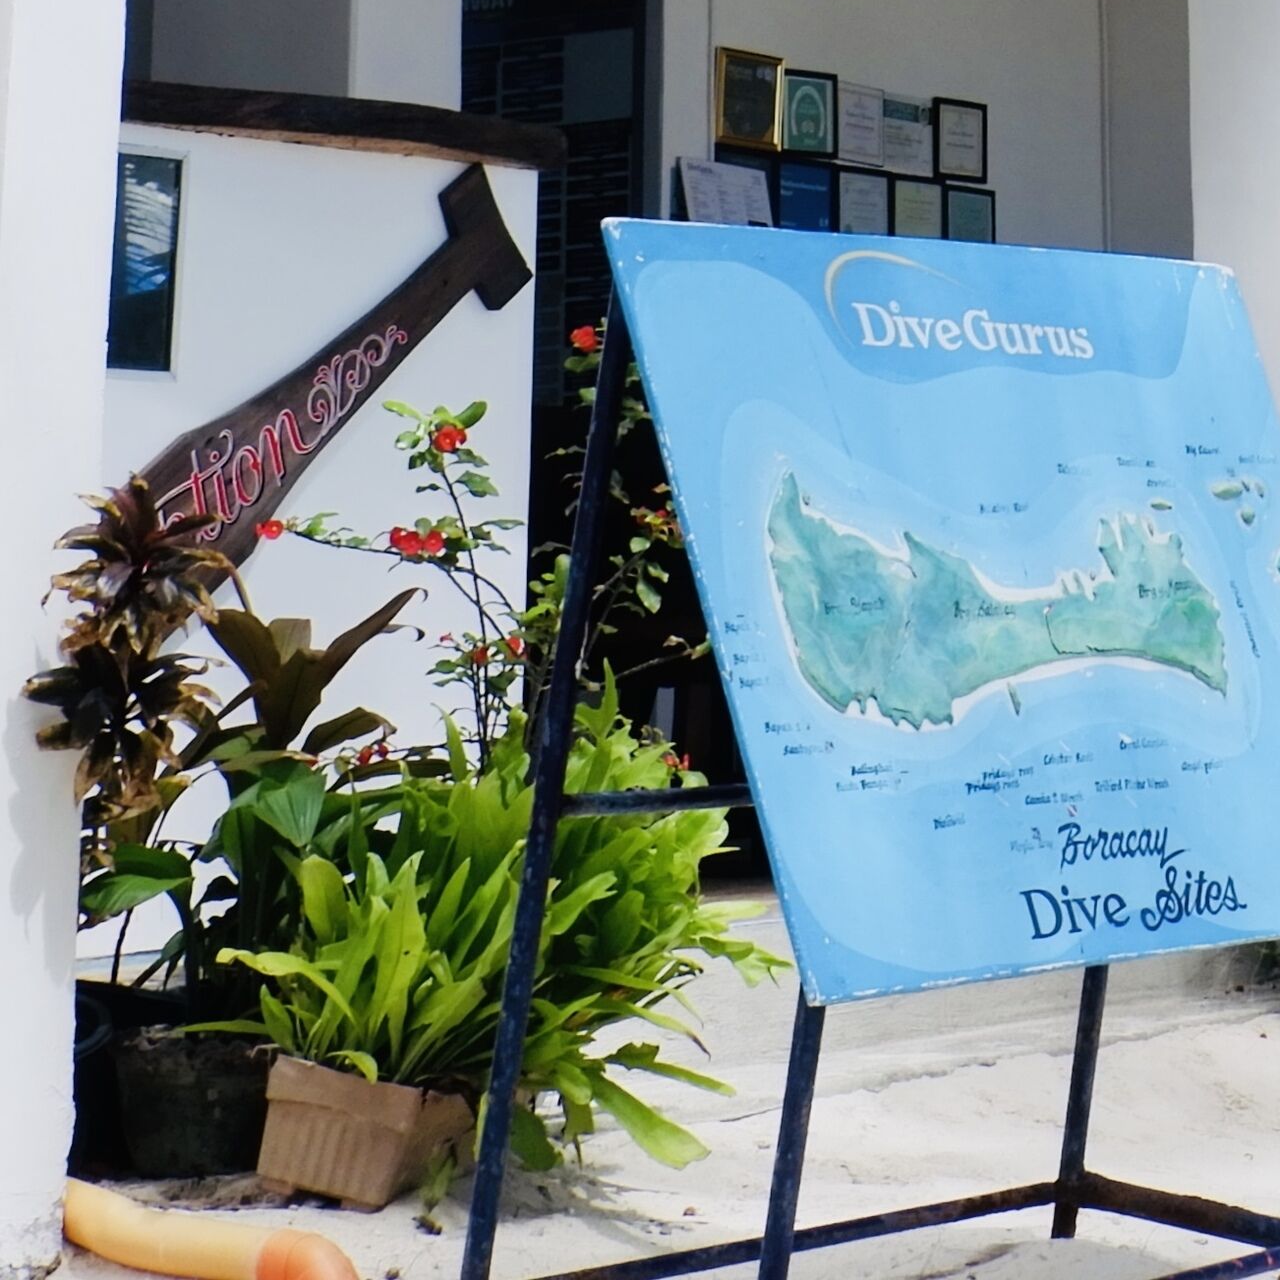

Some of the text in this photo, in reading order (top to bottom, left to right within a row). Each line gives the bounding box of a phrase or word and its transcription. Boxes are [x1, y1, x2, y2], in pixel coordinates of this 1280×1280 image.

[851, 300, 1094, 359] DiveGurus
[1057, 821, 1190, 872] Boracay
[1019, 866, 1248, 940] Dive Sites
